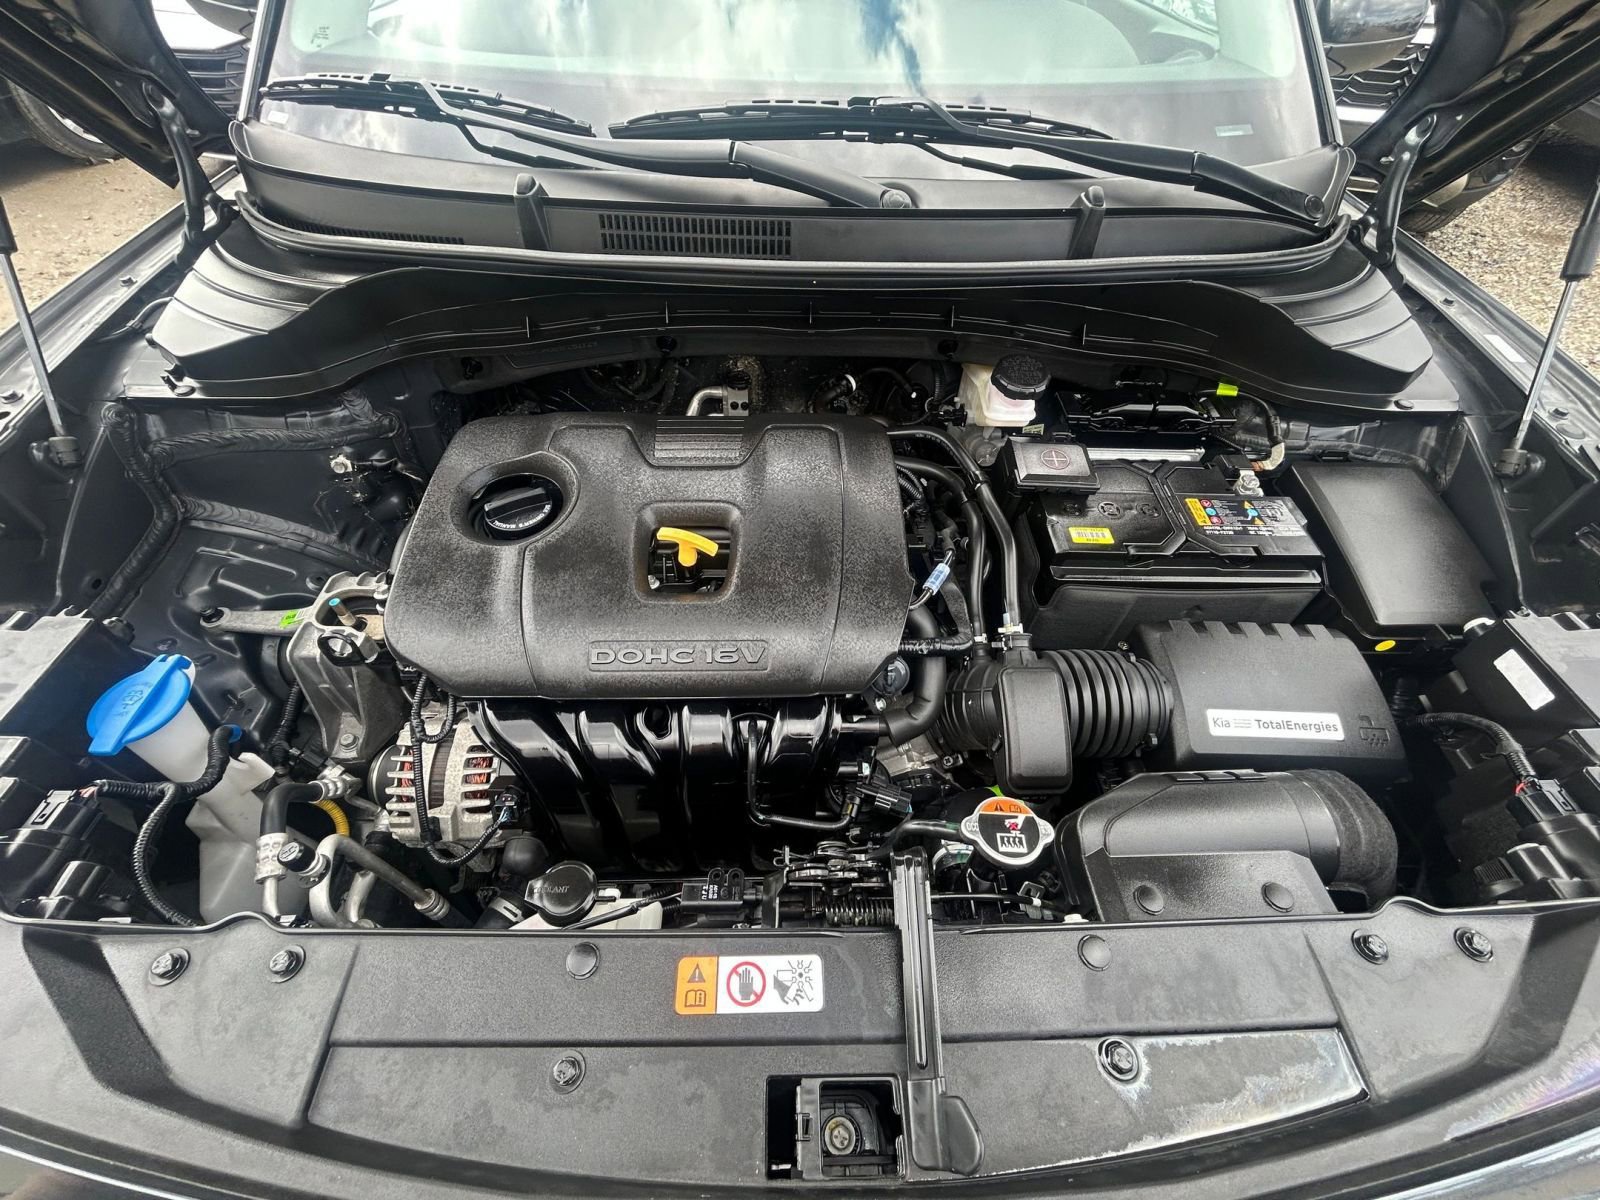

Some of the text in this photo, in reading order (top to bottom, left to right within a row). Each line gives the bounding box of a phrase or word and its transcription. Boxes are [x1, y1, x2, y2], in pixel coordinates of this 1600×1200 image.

[591, 646, 767, 665] DOHC 16V
[1212, 717, 1339, 734] Kia TotalEnergies
